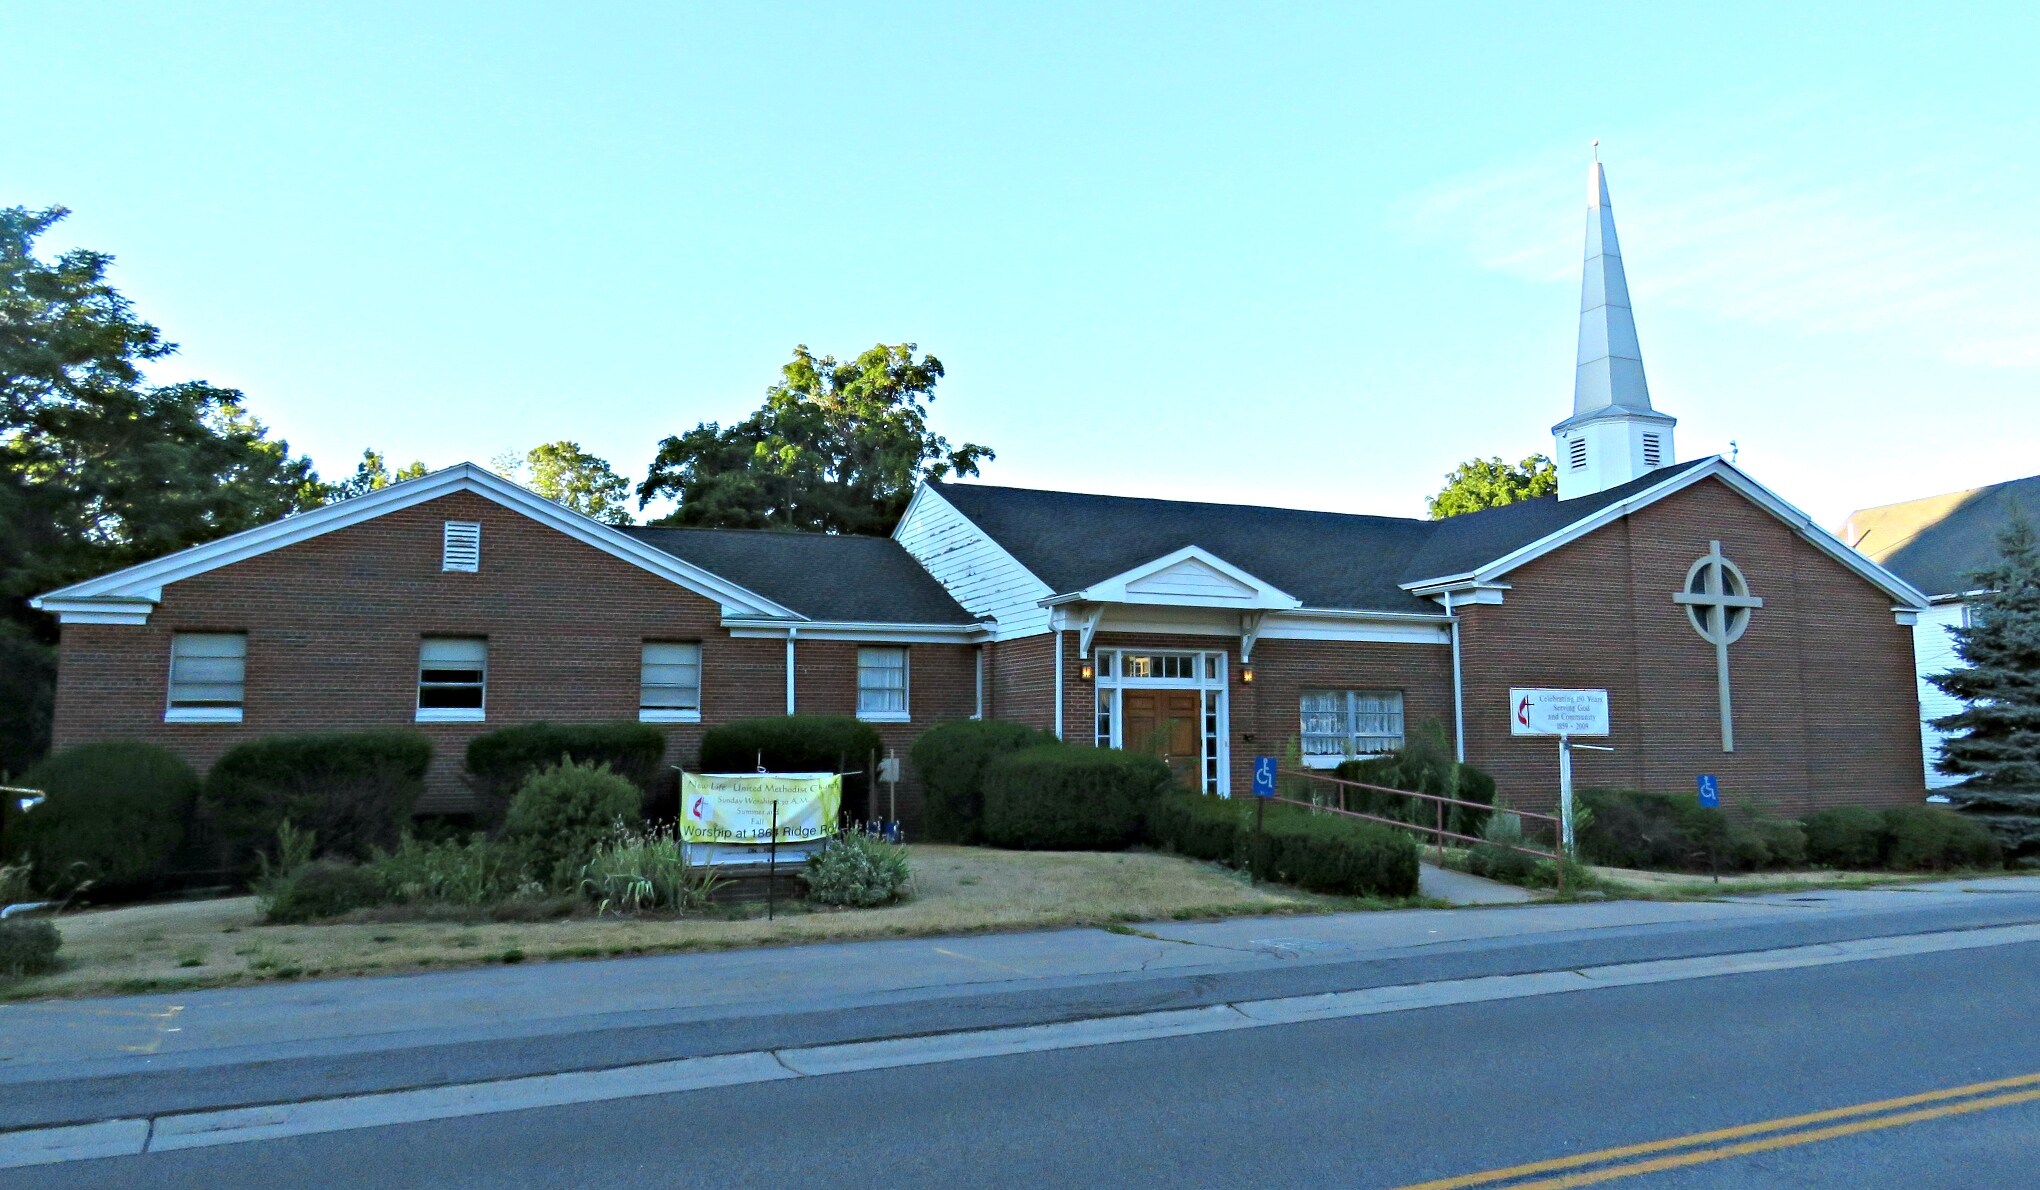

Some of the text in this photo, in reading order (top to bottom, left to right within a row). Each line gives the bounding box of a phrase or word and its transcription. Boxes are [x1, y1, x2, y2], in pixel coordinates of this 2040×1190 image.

[1539, 695, 1575, 703] Celebrating
[1553, 704, 1575, 712] Serving
[1561, 713, 1596, 721] Community
[688, 780, 708, 790] New
[711, 782, 726, 792] Life
[733, 784, 762, 792] United
[766, 784, 807, 793] Methodist
[718, 796, 742, 805] Sunday
[744, 797, 774, 806] Worship
[751, 817, 764, 825] Fall
[684, 825, 732, 840] Worship
[735, 829, 746, 839] at
[783, 825, 816, 838] Ridge
